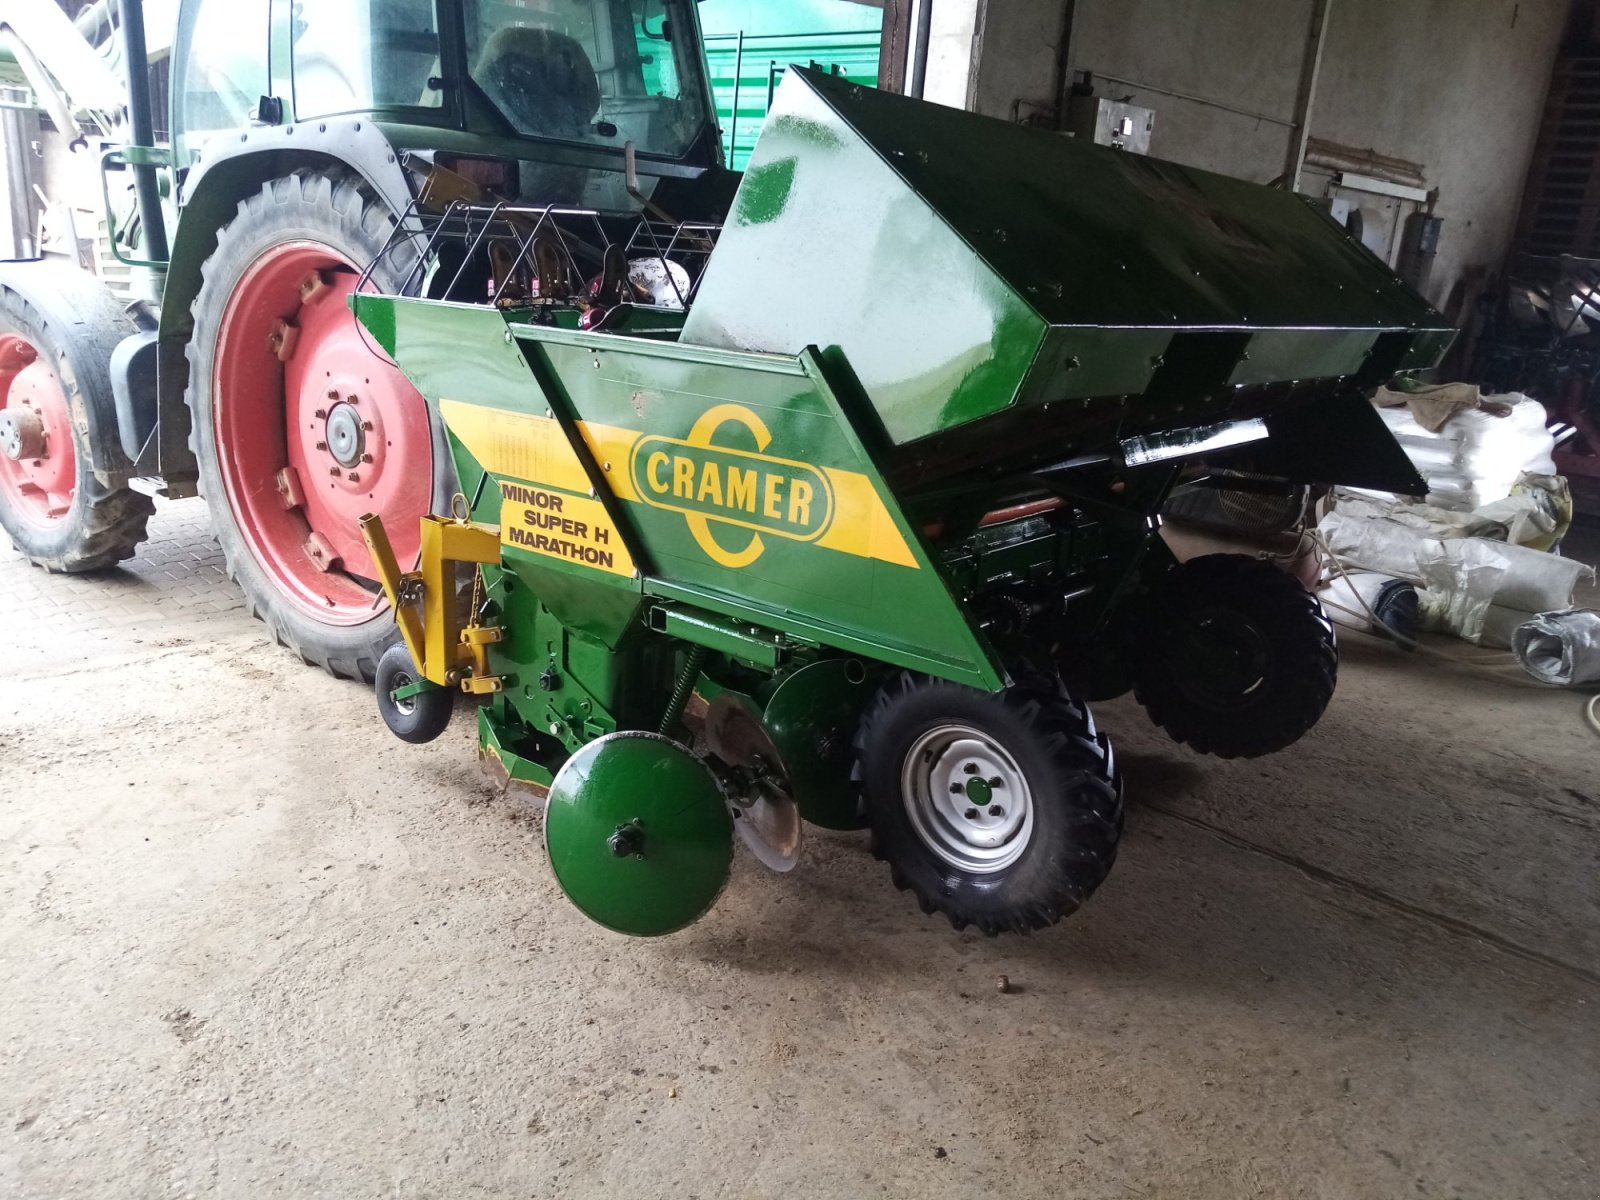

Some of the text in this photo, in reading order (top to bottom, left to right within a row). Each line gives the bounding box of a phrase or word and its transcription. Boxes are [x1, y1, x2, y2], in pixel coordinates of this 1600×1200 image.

[502, 484, 563, 513] MINOR
[646, 451, 813, 526] CRAMER
[524, 509, 609, 545] SUPER H
[509, 526, 613, 568] MARATHON
